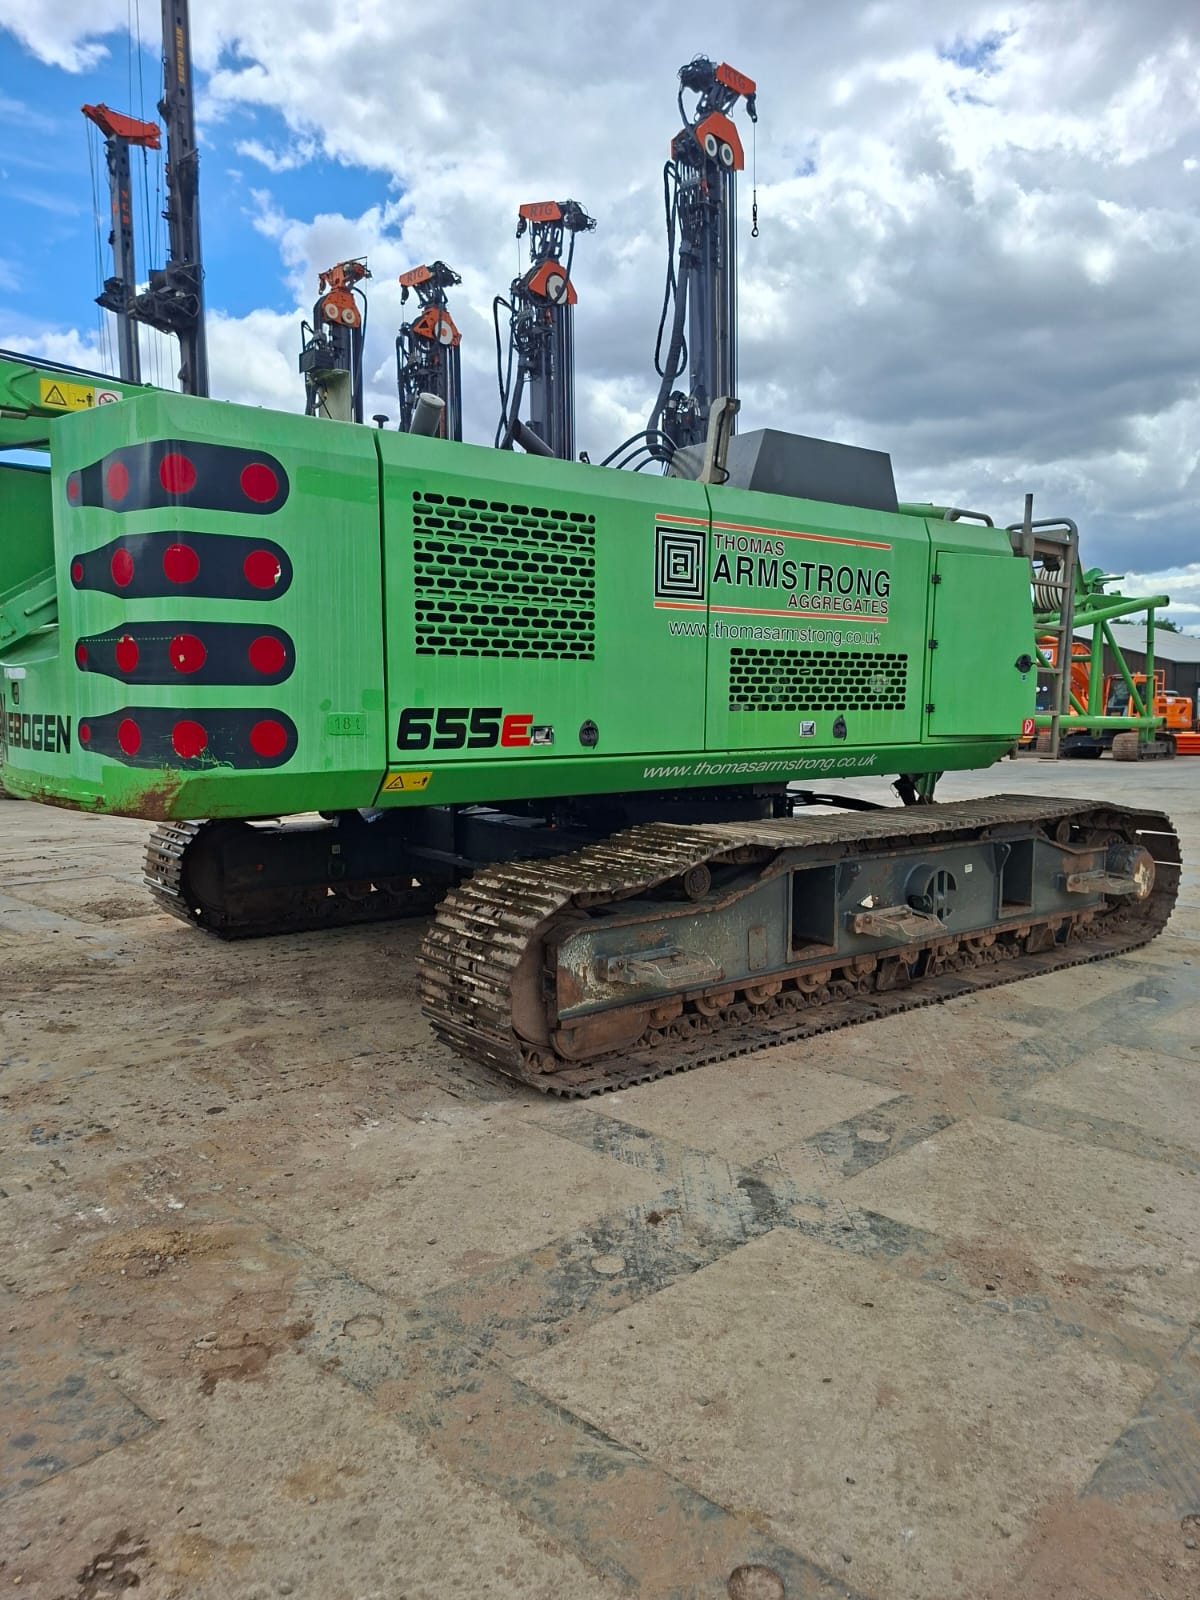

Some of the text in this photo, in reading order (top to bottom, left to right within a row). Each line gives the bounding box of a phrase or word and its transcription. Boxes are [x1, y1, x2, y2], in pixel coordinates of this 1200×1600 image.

[529, 205, 552, 217] RTG
[406, 270, 423, 283] RTG
[713, 534, 785, 556] THOMAS
[712, 554, 891, 598] ARMSTRONG
[787, 594, 889, 614] AGGREGATES
[668, 620, 881, 647] www.thomasarmstrong.co.uk
[396, 707, 534, 751] 655E
[643, 752, 877, 779] www.thomasarmstrong.co.uk
